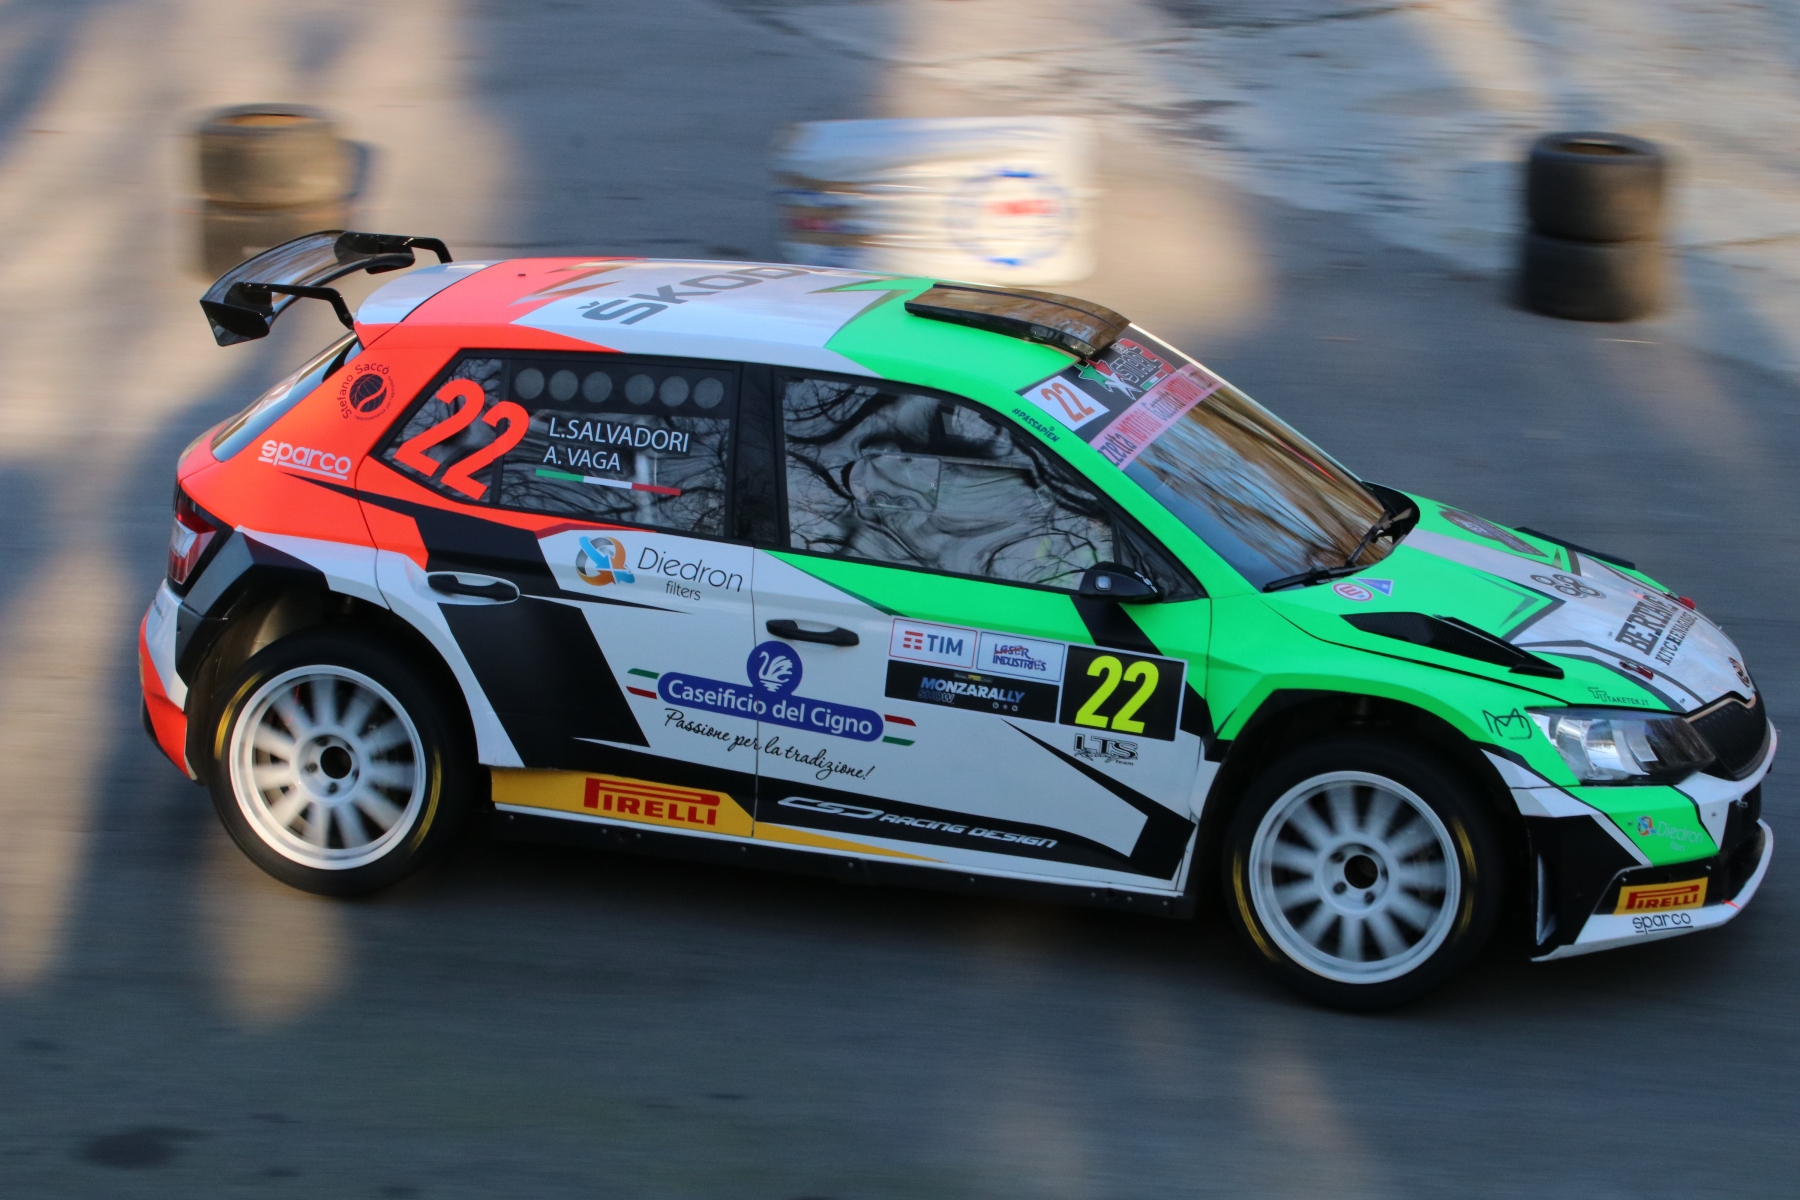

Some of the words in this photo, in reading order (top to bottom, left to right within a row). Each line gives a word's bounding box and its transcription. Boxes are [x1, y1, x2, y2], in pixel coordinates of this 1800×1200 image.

[577, 266, 814, 326] ŠKOD
[337, 374, 354, 419] Stefano
[1041, 382, 1096, 423] 22
[393, 378, 530, 501] 22
[549, 417, 690, 453] L.SALVADORI
[1012, 408, 1060, 443] #PASSAPIEN
[1115, 407, 1163, 446] MOTORI
[261, 439, 352, 475] sparco
[542, 445, 563, 465] A.
[567, 447, 621, 471] VAGA
[637, 546, 743, 593] Diedron
[665, 580, 701, 601] filters
[927, 633, 964, 657] TIM
[667, 678, 768, 716] Caseificio
[771, 700, 805, 723] del
[810, 707, 873, 736] Cigno
[1074, 655, 1159, 734] 22
[664, 707, 730, 742] Passione
[728, 732, 762, 752] per
[764, 736, 782, 757] la
[784, 745, 876, 781] tradizione!
[1074, 733, 1138, 760] LTS
[583, 777, 721, 826] PIRELLI
[878, 813, 970, 835] RACING
[968, 827, 1058, 849] DESIGN
[1656, 820, 1704, 844] Diedron
[1625, 884, 1700, 911] PIRELLI
[1632, 912, 1692, 935] sparco
